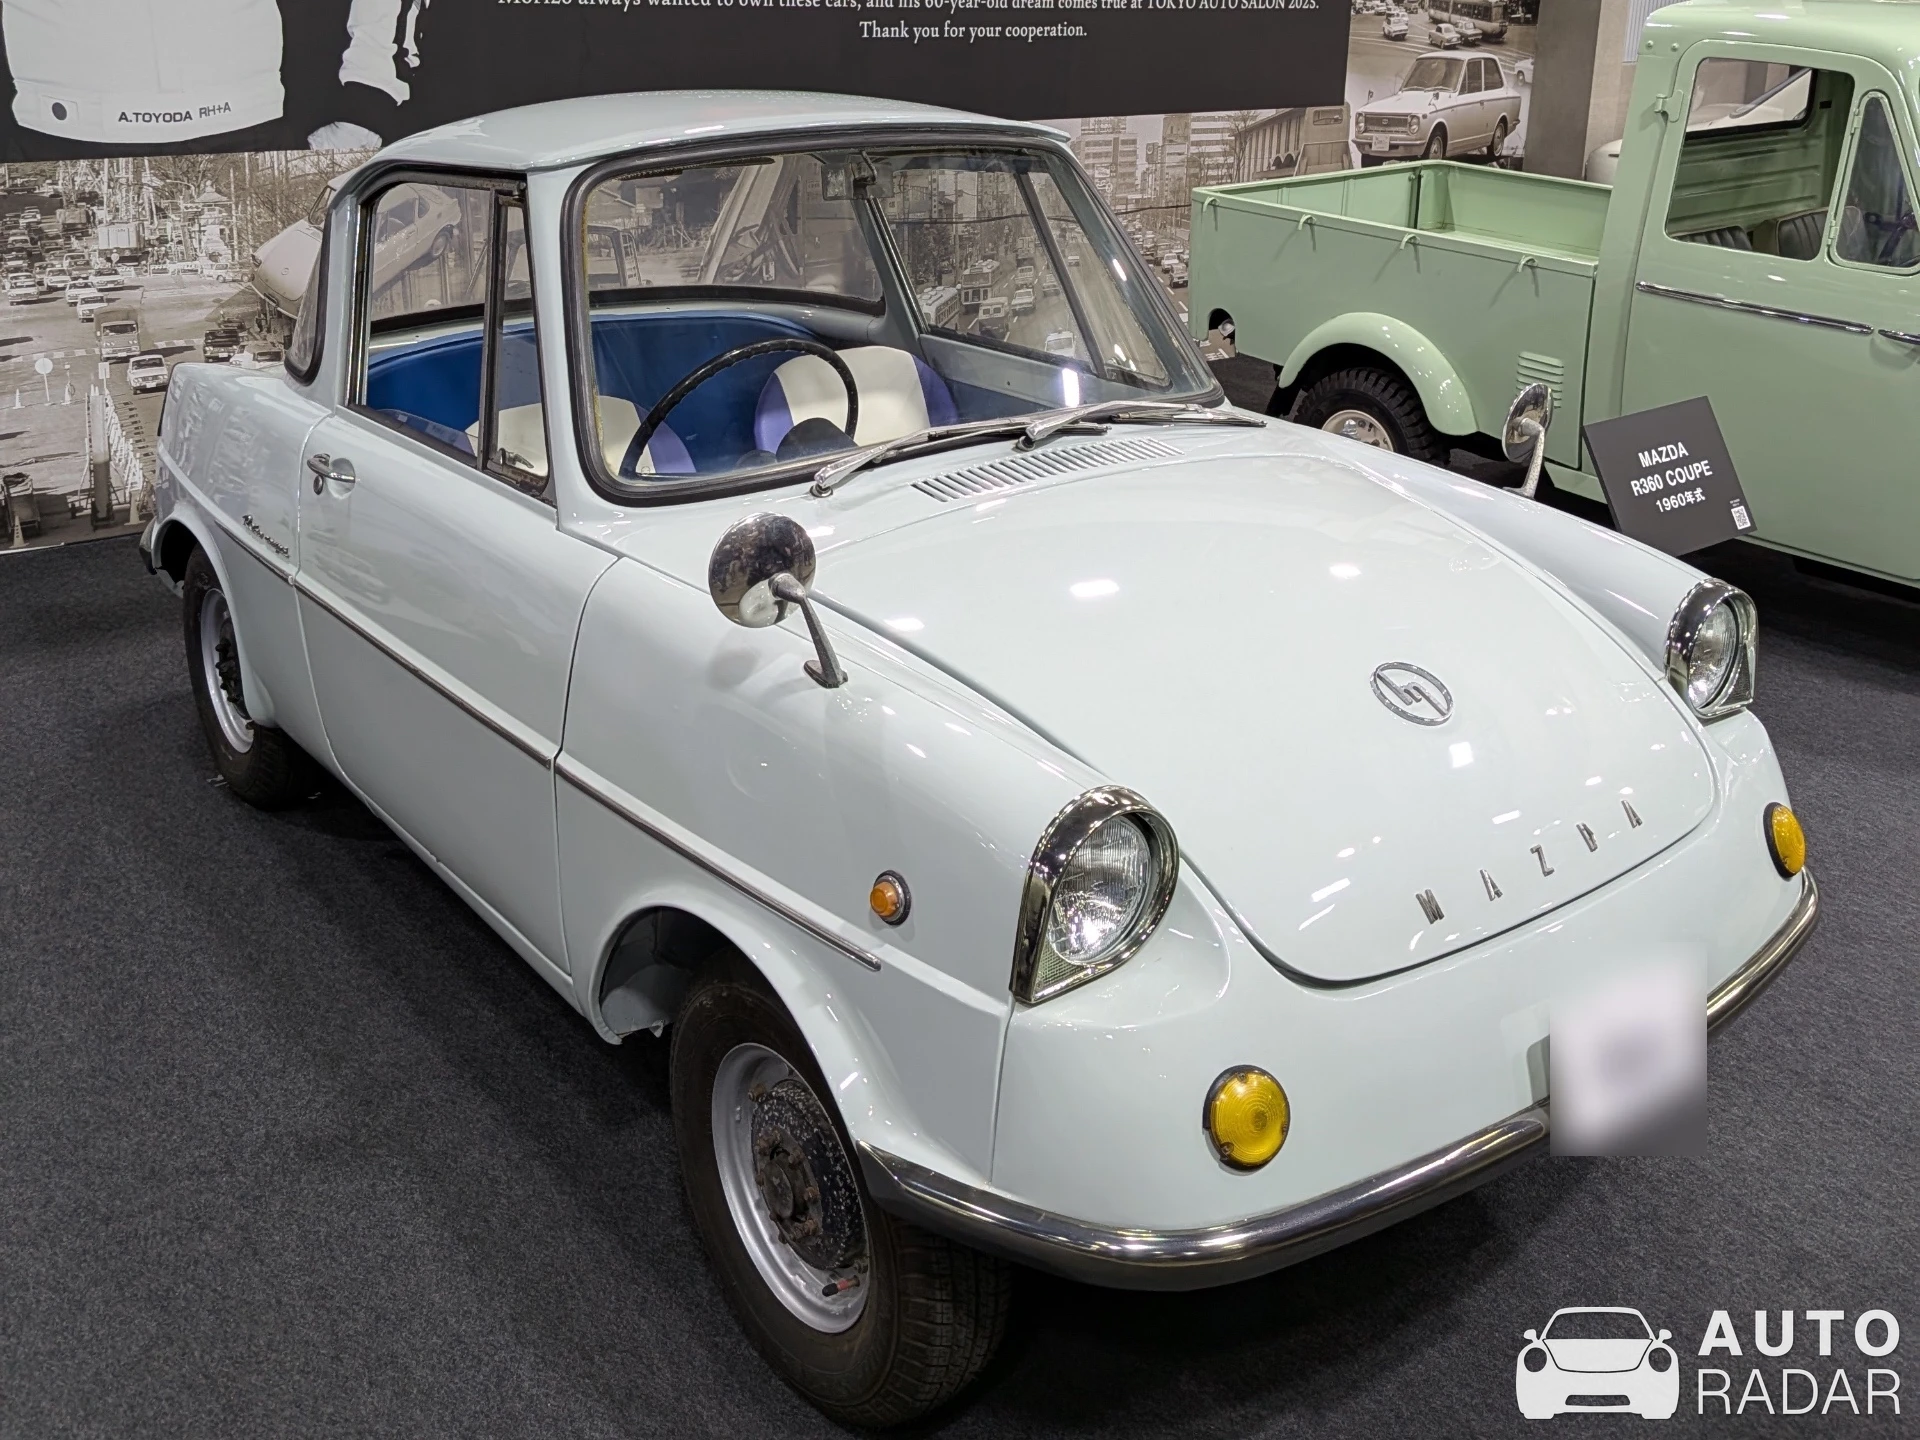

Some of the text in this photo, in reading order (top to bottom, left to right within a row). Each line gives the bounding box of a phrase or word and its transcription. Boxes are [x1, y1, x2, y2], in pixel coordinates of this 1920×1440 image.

[578, 0, 641, 12] aways
[826, 0, 862, 11] cars,
[1012, 0, 1055, 9] dream
[1058, 0, 1098, 9] comes
[1101, 0, 1127, 9] true
[1130, 0, 1142, 9] at
[1147, 0, 1196, 9] TOKYO
[1198, 0, 1239, 9] AUTO
[1241, 0, 1285, 9] SALON
[859, 20, 1088, 44] Thank you for your cooperation.
[118, 101, 232, 123] A.TOYODA RH+A
[1637, 441, 1689, 468] MAZDA
[1630, 459, 1713, 497] R360 COUPE
[1655, 487, 1706, 513] 1960年式
[1415, 799, 1643, 925] MAZDA
